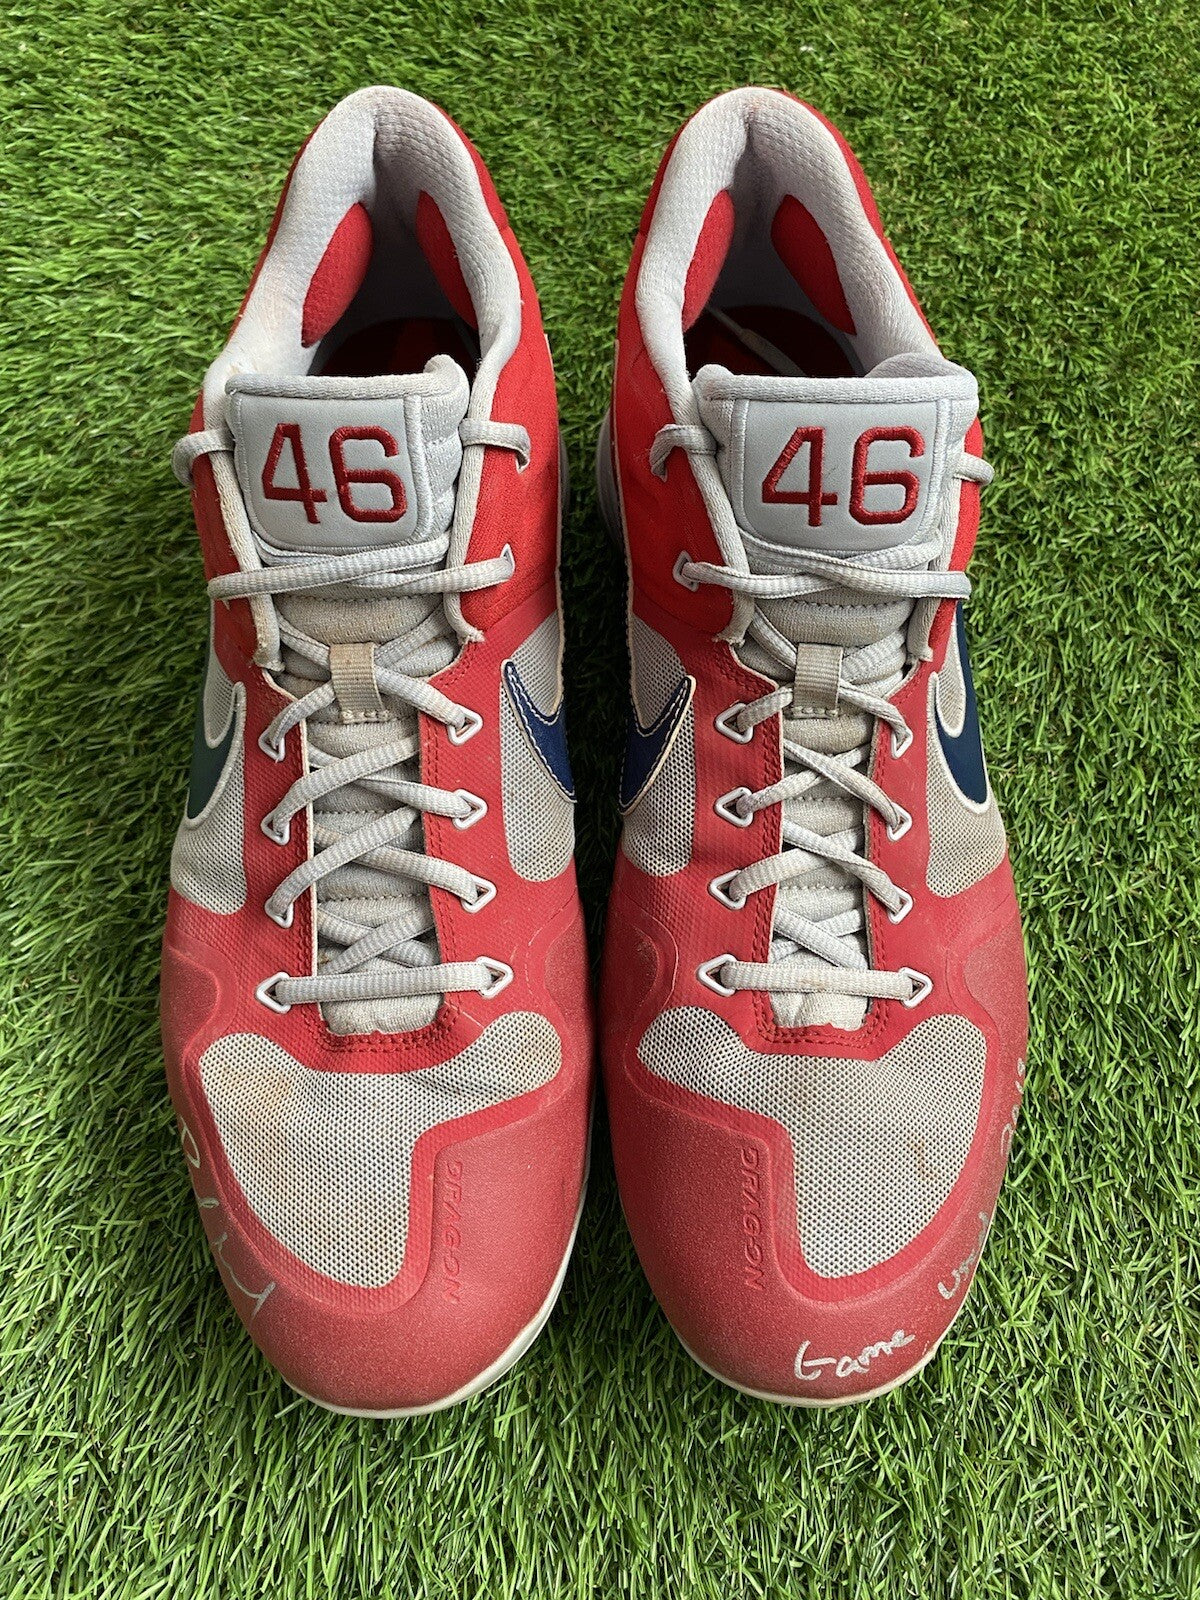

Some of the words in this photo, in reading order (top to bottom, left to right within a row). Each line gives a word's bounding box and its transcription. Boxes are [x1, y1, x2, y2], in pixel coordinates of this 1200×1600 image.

[261, 422, 408, 524] 46
[761, 426, 926, 528] 46
[794, 1329, 915, 1381] Game
